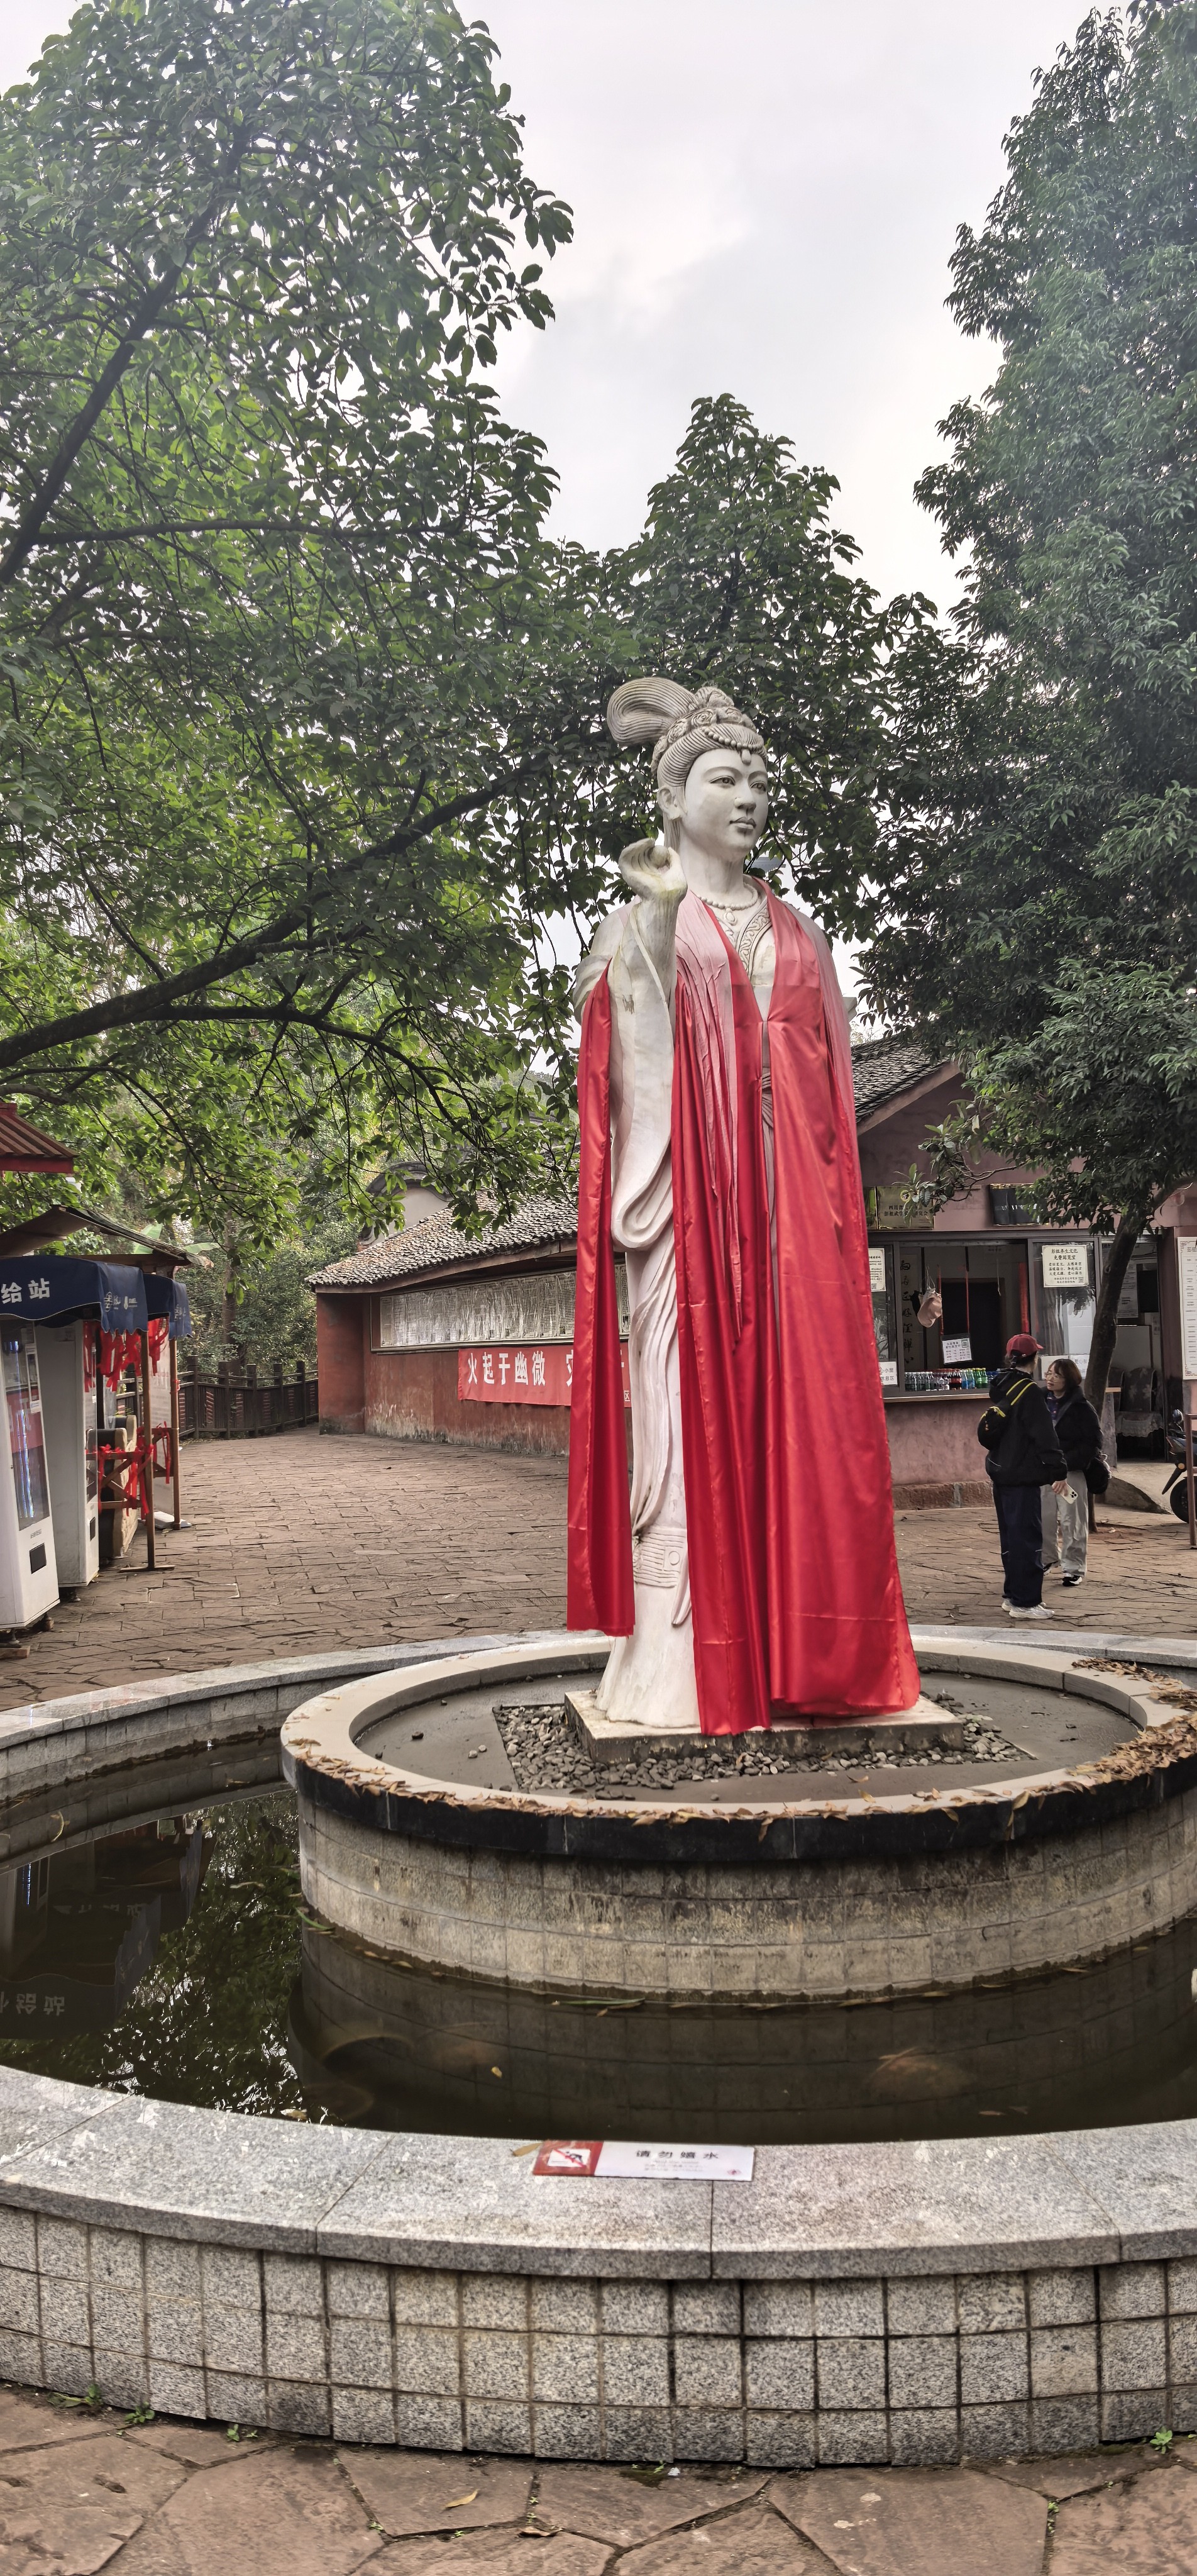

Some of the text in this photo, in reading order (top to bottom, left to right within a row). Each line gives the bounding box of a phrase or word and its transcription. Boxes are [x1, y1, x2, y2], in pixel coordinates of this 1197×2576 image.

[1, 1278, 50, 1304] 给站
[468, 1350, 546, 1387] 火起于幽微
